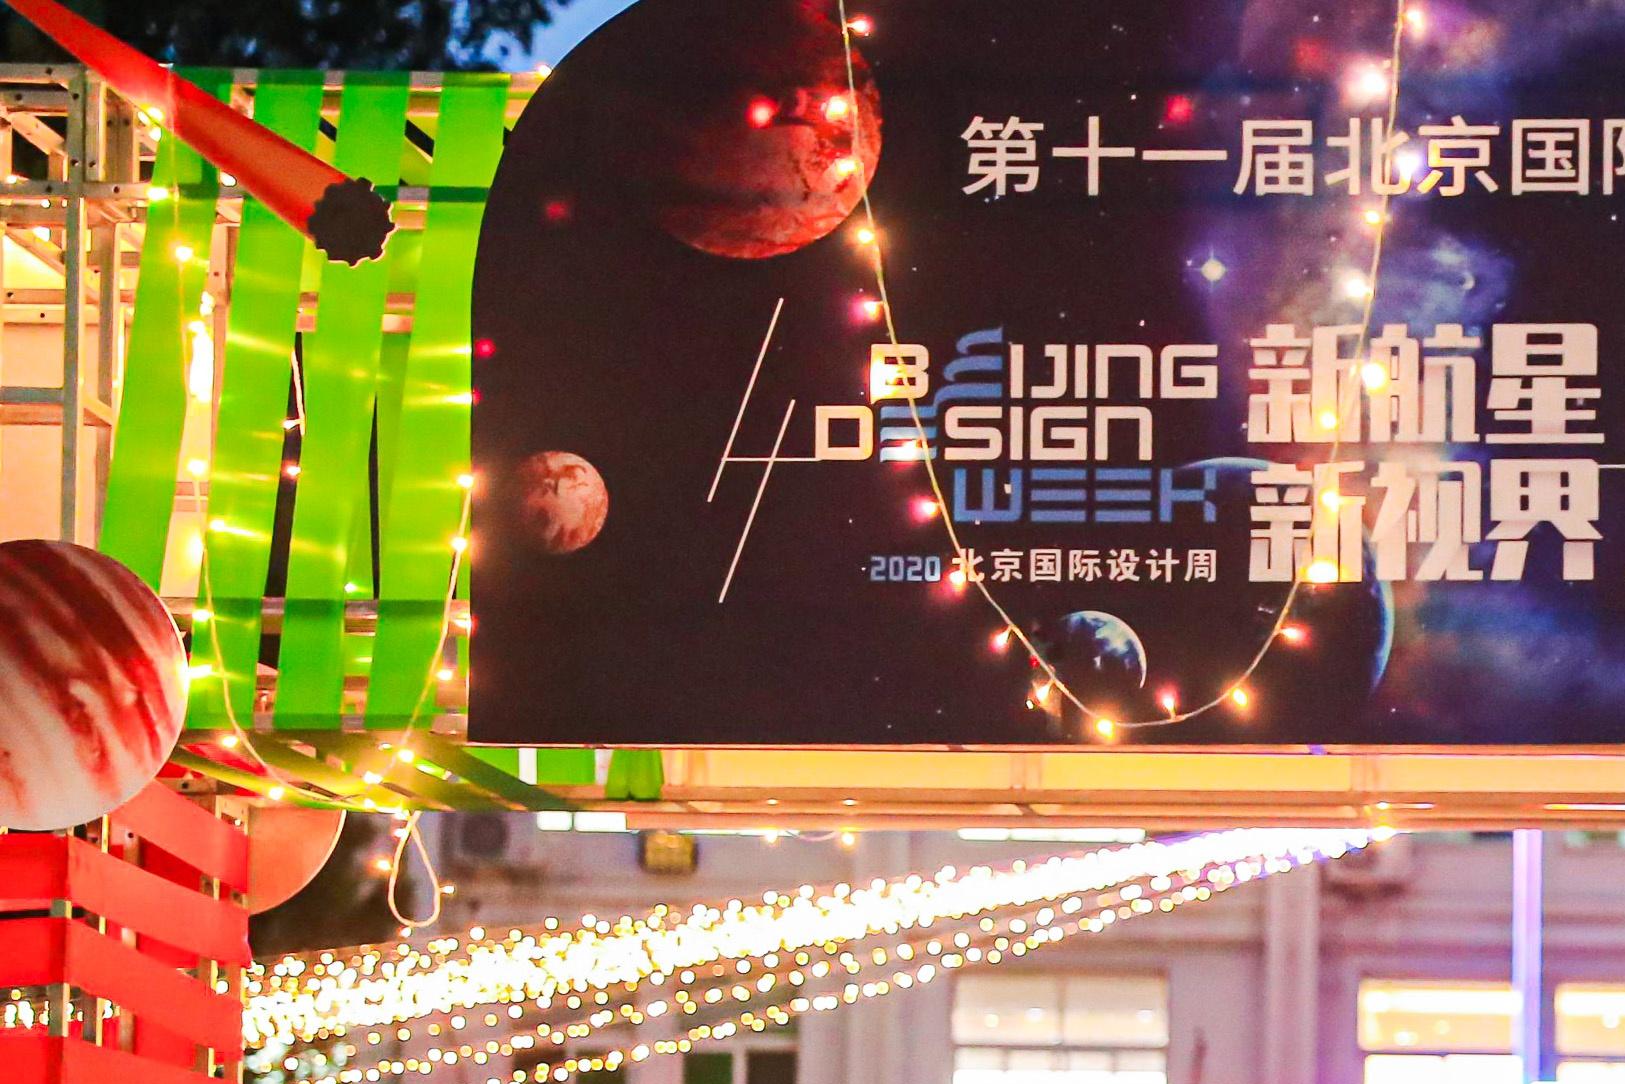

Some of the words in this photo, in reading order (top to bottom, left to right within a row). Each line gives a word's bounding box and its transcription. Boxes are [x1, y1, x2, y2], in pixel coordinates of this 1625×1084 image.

[870, 327, 1218, 402] BEIJING
[1248, 323, 1605, 444] 新航星
[815, 405, 1153, 461] DESIGN
[953, 468, 1216, 523] WEEK
[1248, 457, 1604, 583] 新视界
[869, 556, 941, 582] 2020
[951, 548, 1218, 584] 北京国际设计周
